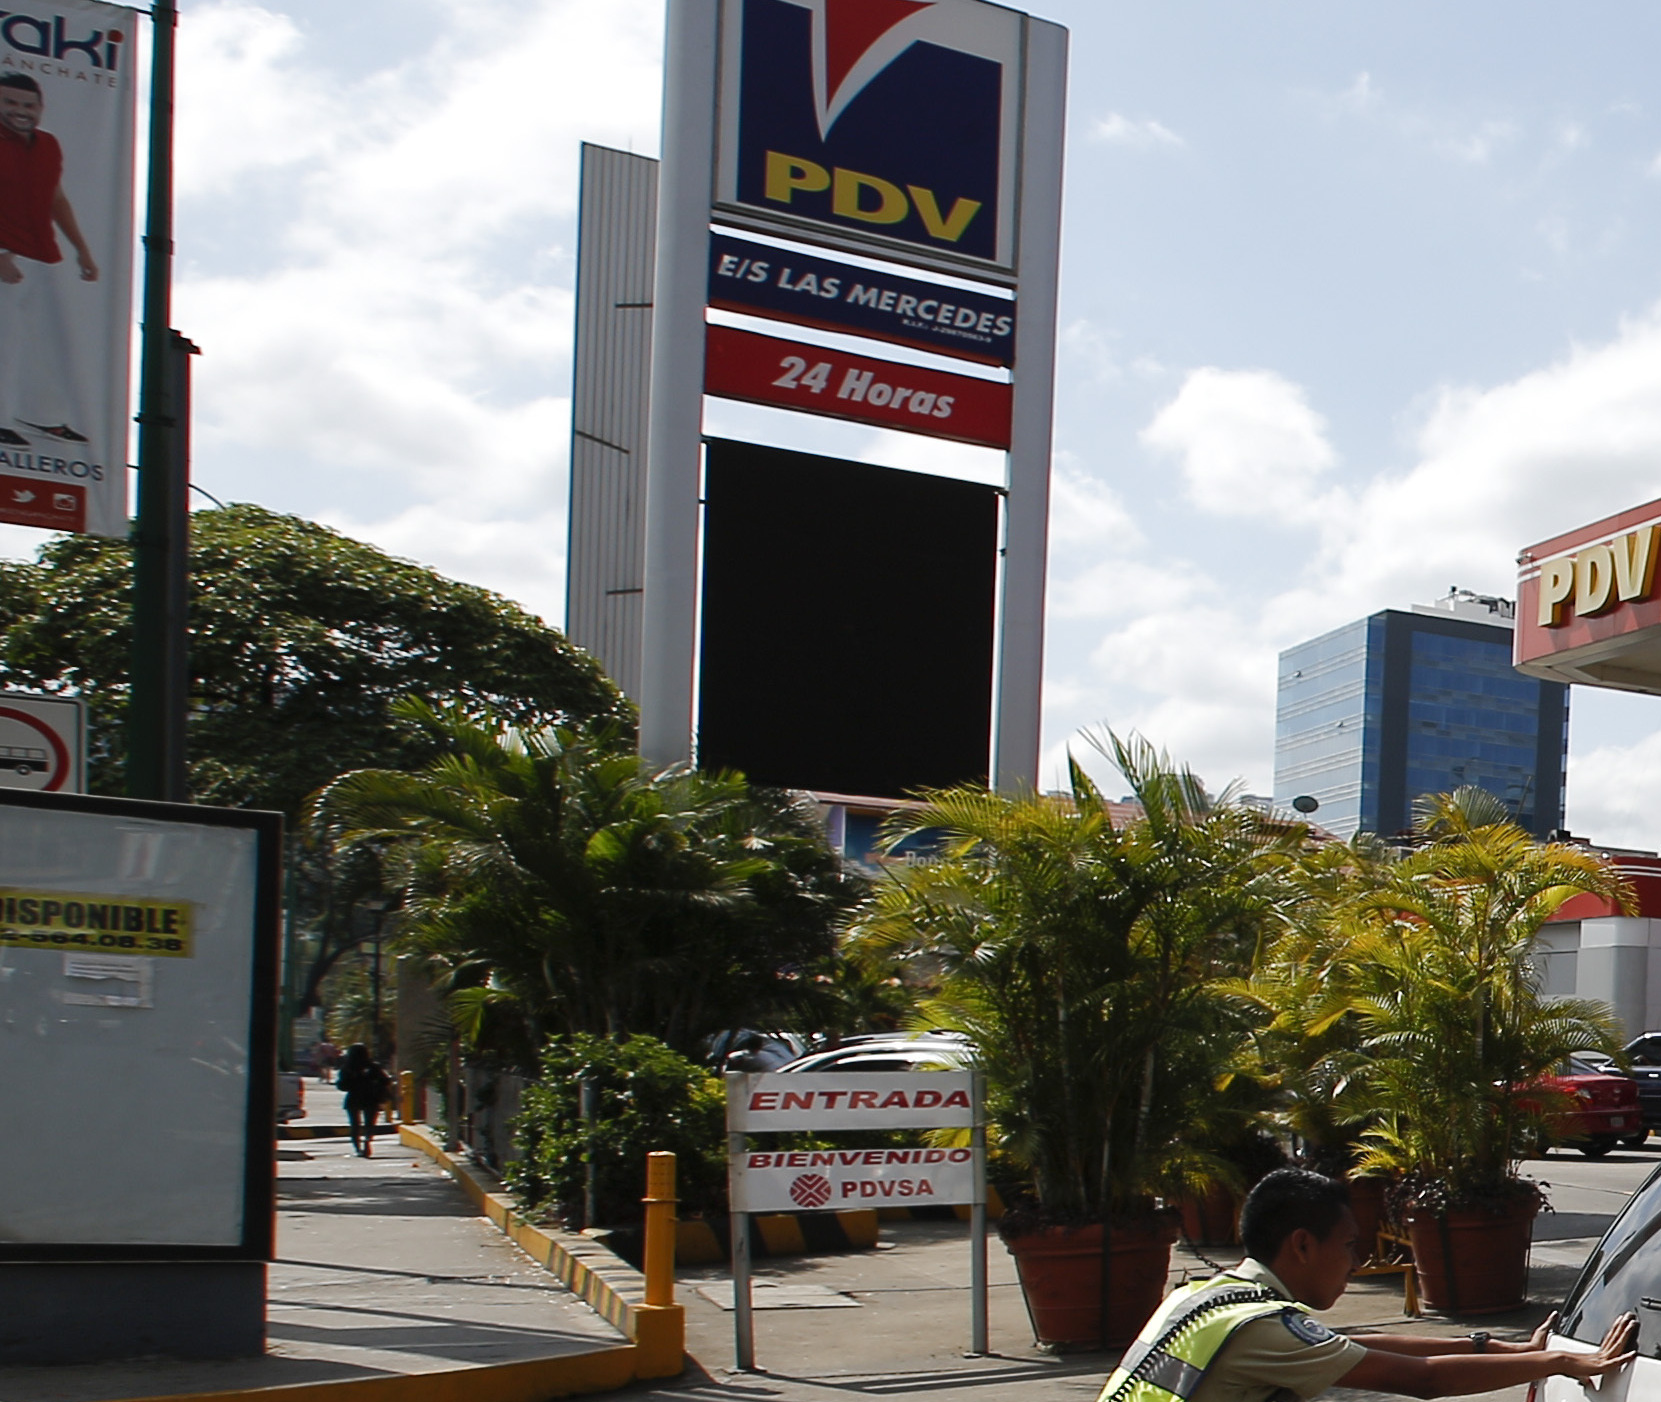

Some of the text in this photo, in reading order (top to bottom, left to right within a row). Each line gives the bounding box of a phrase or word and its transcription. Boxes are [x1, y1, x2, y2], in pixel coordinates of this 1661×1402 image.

[0, 10, 124, 71] aki
[765, 150, 982, 242] PDV
[717, 254, 1013, 336] E/S LAS MERCEDES
[771, 355, 955, 418] 24 Horas
[0, 897, 178, 934] ISPONIBLE
[748, 1090, 971, 1111] ENTRADA
[748, 1149, 971, 1168] BIENVENIDO
[841, 1179, 934, 1198] PDVSA
